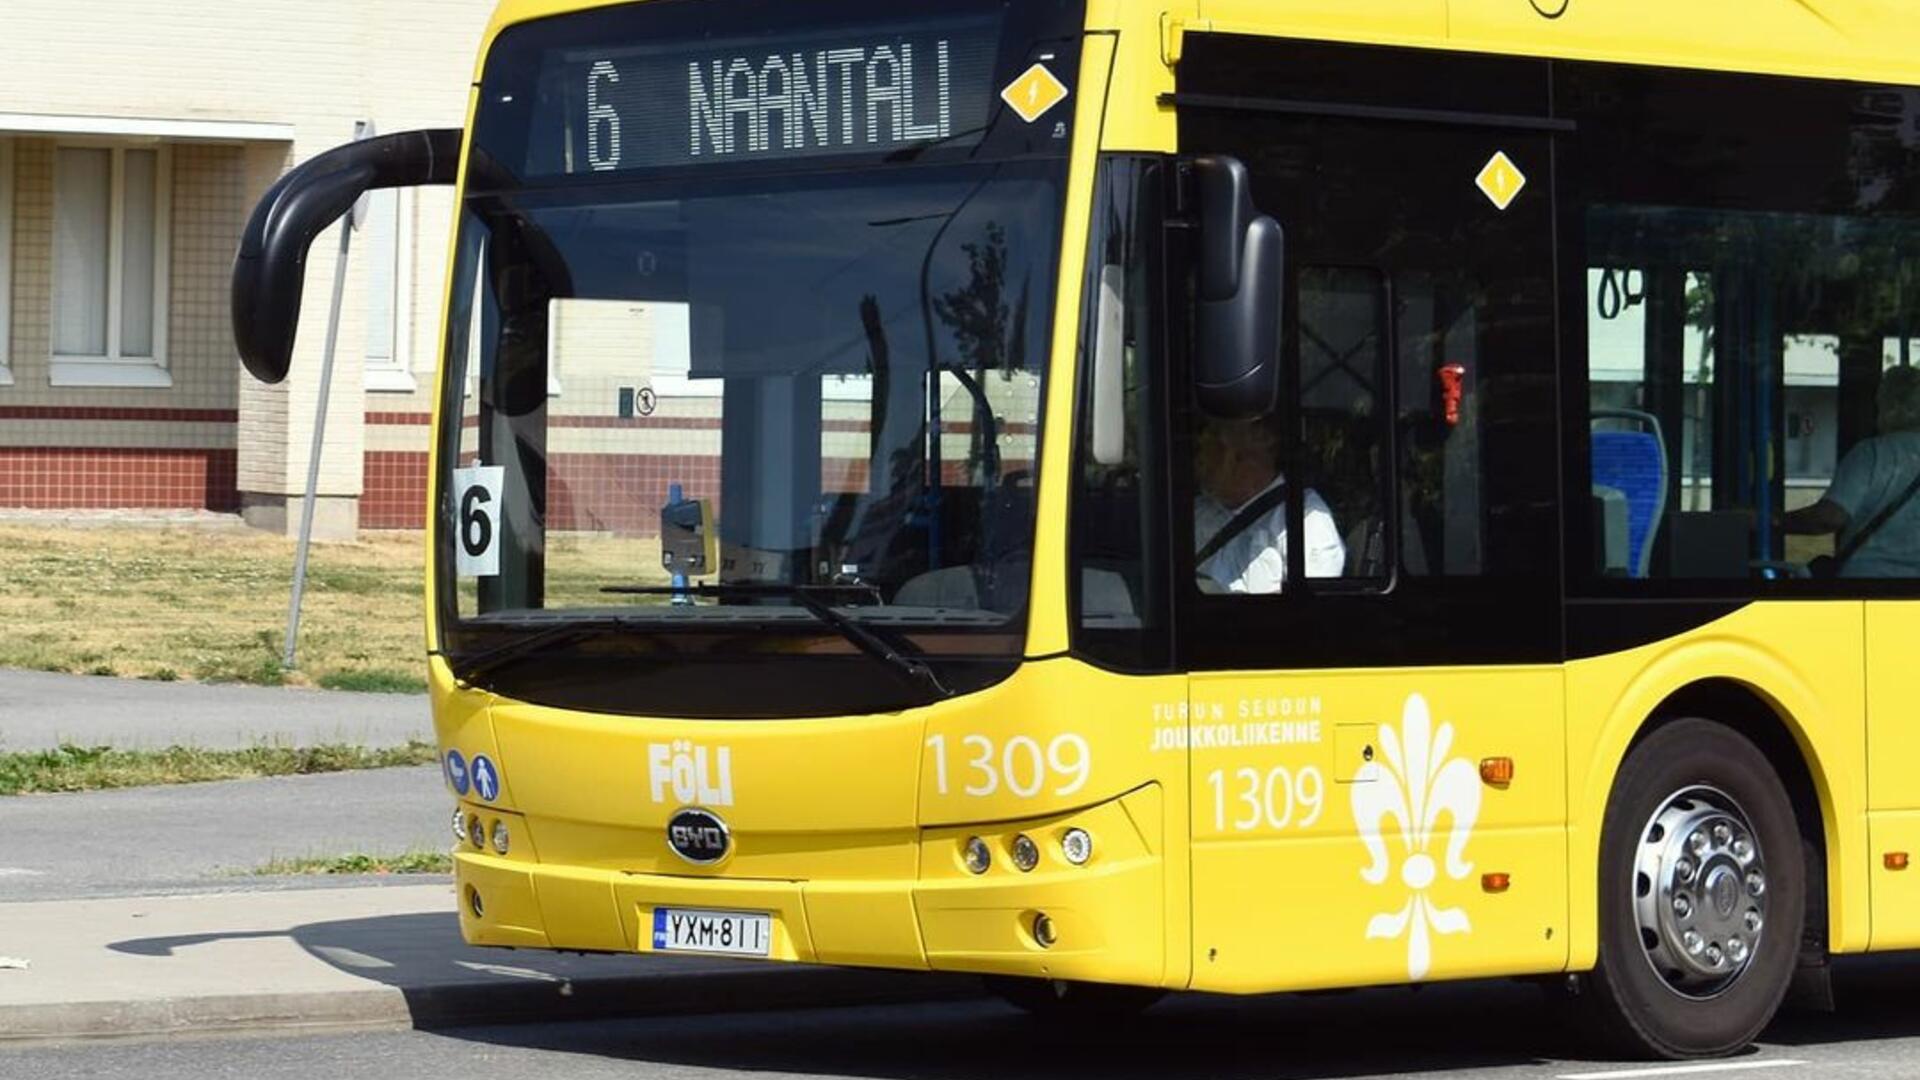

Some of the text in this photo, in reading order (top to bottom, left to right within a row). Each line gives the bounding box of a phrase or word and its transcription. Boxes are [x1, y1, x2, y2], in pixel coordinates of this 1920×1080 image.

[588, 40, 949, 171] 6 NAANTALI
[461, 484, 493, 557] 6
[1150, 720, 1322, 751] JOUKKOLIIKENNE
[1152, 702, 1224, 721] TURUN
[926, 732, 1091, 798] 1309
[1208, 765, 1325, 832] 1309
[671, 825, 723, 850] BYD
[671, 914, 760, 949] YXM-811
